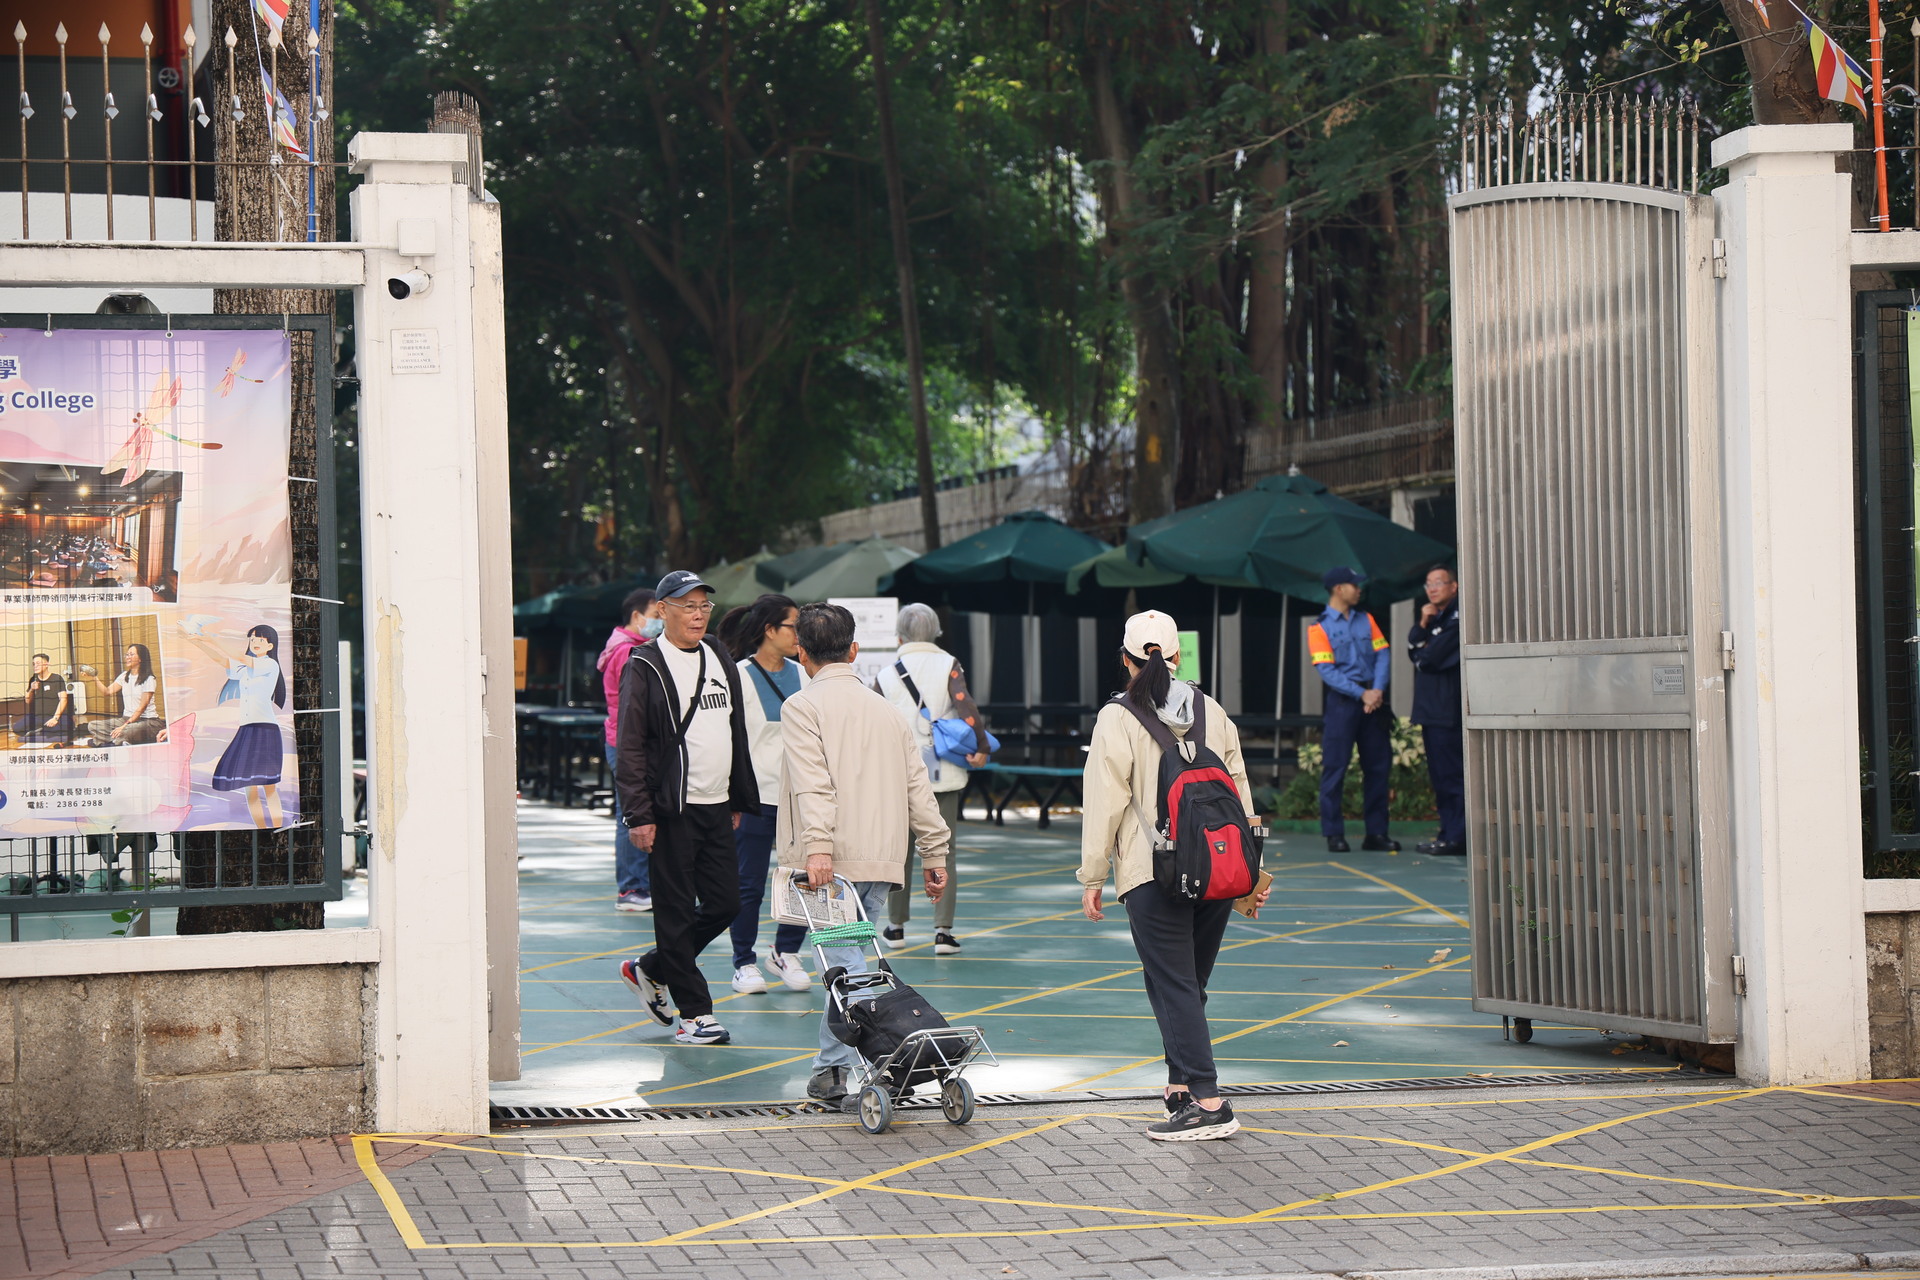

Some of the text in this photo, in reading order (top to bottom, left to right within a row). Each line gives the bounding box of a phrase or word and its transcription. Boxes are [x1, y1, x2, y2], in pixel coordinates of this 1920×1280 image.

[11, 390, 94, 413] College
[699, 693, 727, 711] UMA
[21, 787, 112, 797] 九龍長沙灣長發街38號
[57, 800, 78, 808] 2386
[81, 799, 103, 807] 2988
